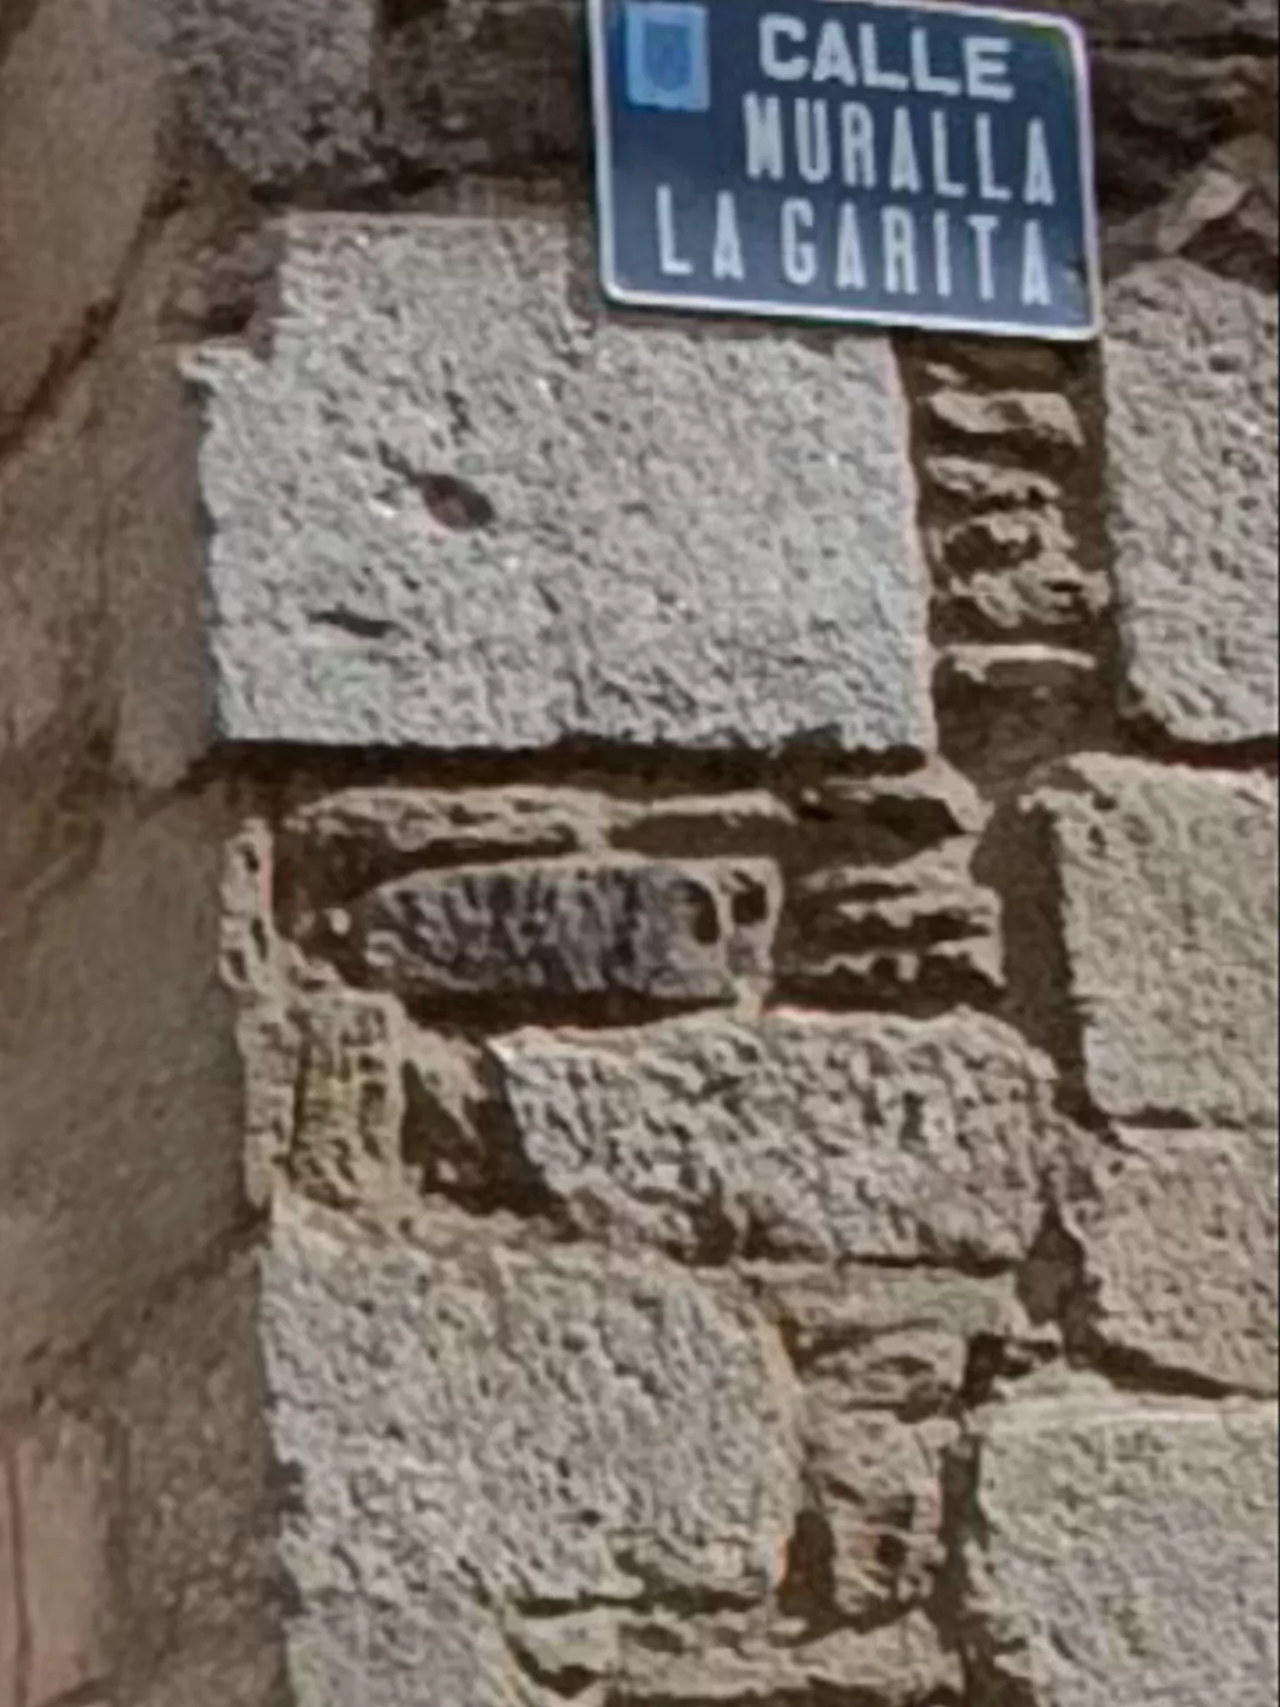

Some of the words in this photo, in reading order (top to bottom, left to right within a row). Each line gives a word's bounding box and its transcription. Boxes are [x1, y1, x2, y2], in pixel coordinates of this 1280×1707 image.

[759, 13, 1014, 101] CALLE
[743, 93, 1054, 205] MURALLA
[656, 185, 744, 280] LA
[781, 198, 1051, 305] GARITA
